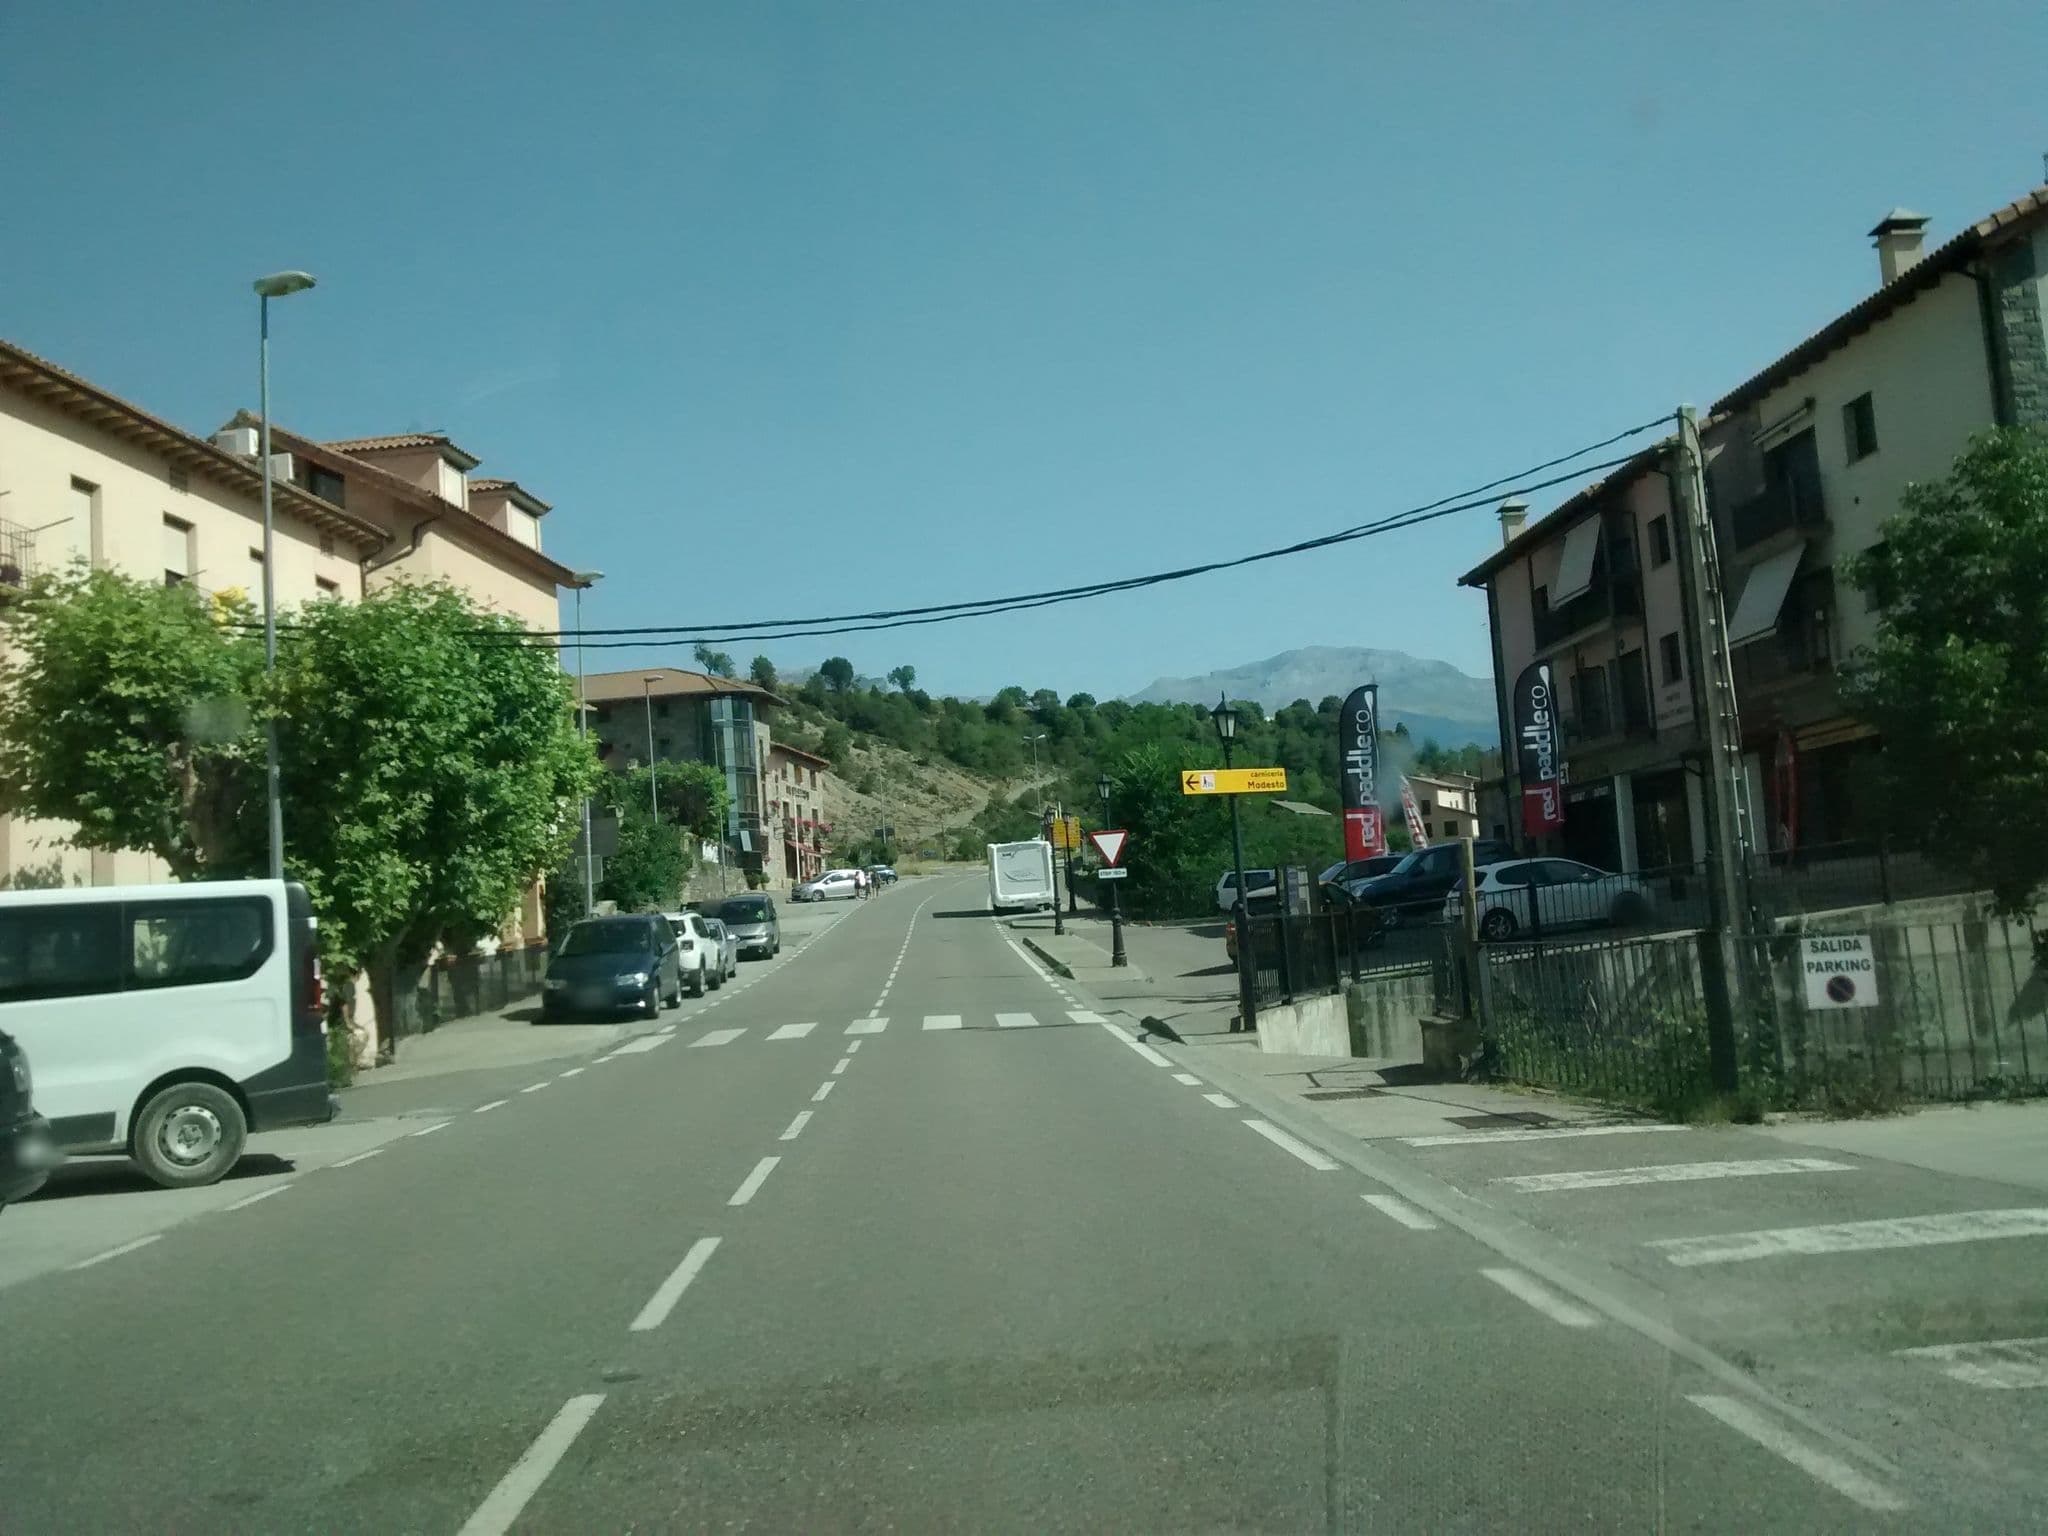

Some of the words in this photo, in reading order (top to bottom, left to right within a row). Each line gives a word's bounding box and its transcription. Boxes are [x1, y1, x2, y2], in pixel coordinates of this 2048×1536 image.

[1247, 781, 1285, 790] Modesto
[1525, 787, 1556, 821] red
[1346, 813, 1376, 848] red
[1810, 939, 1862, 953] SALIDA
[1806, 958, 1871, 973] PARKING
